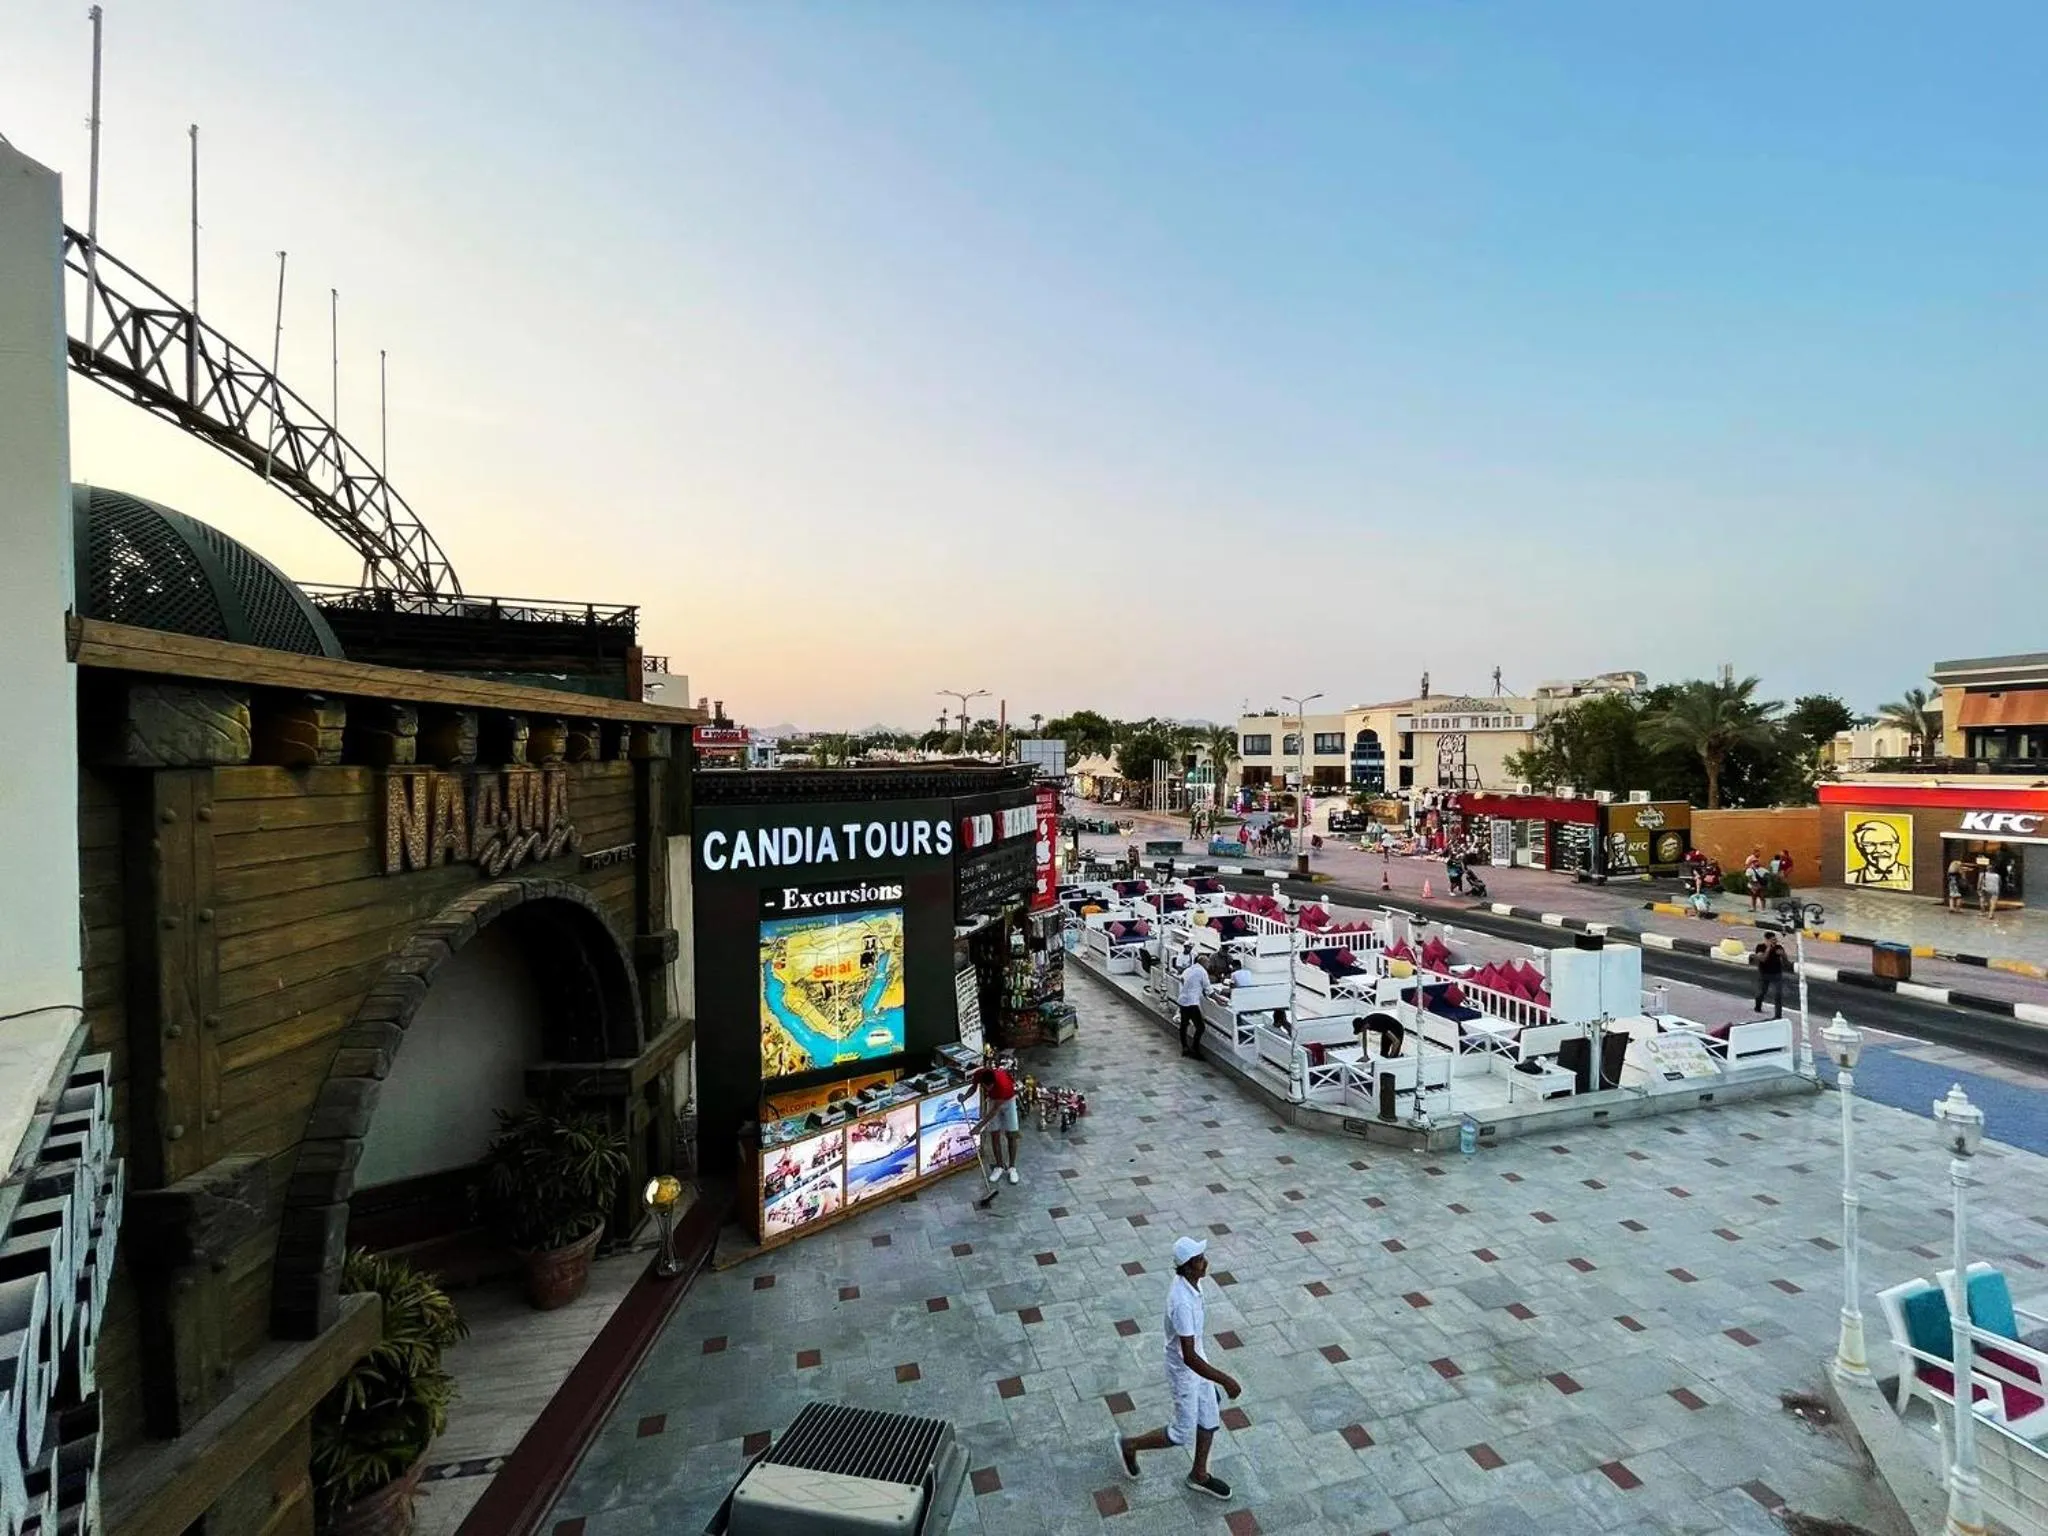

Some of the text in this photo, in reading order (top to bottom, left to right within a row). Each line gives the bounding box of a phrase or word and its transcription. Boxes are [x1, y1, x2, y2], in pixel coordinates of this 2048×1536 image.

[1960, 811, 2040, 833] KFC
[703, 820, 952, 871] CANDIA TOURS
[1628, 841, 1648, 852] KFC
[592, 846, 637, 870] HOTEL
[782, 882, 903, 910] Excursions
[813, 960, 853, 978] Sinai
